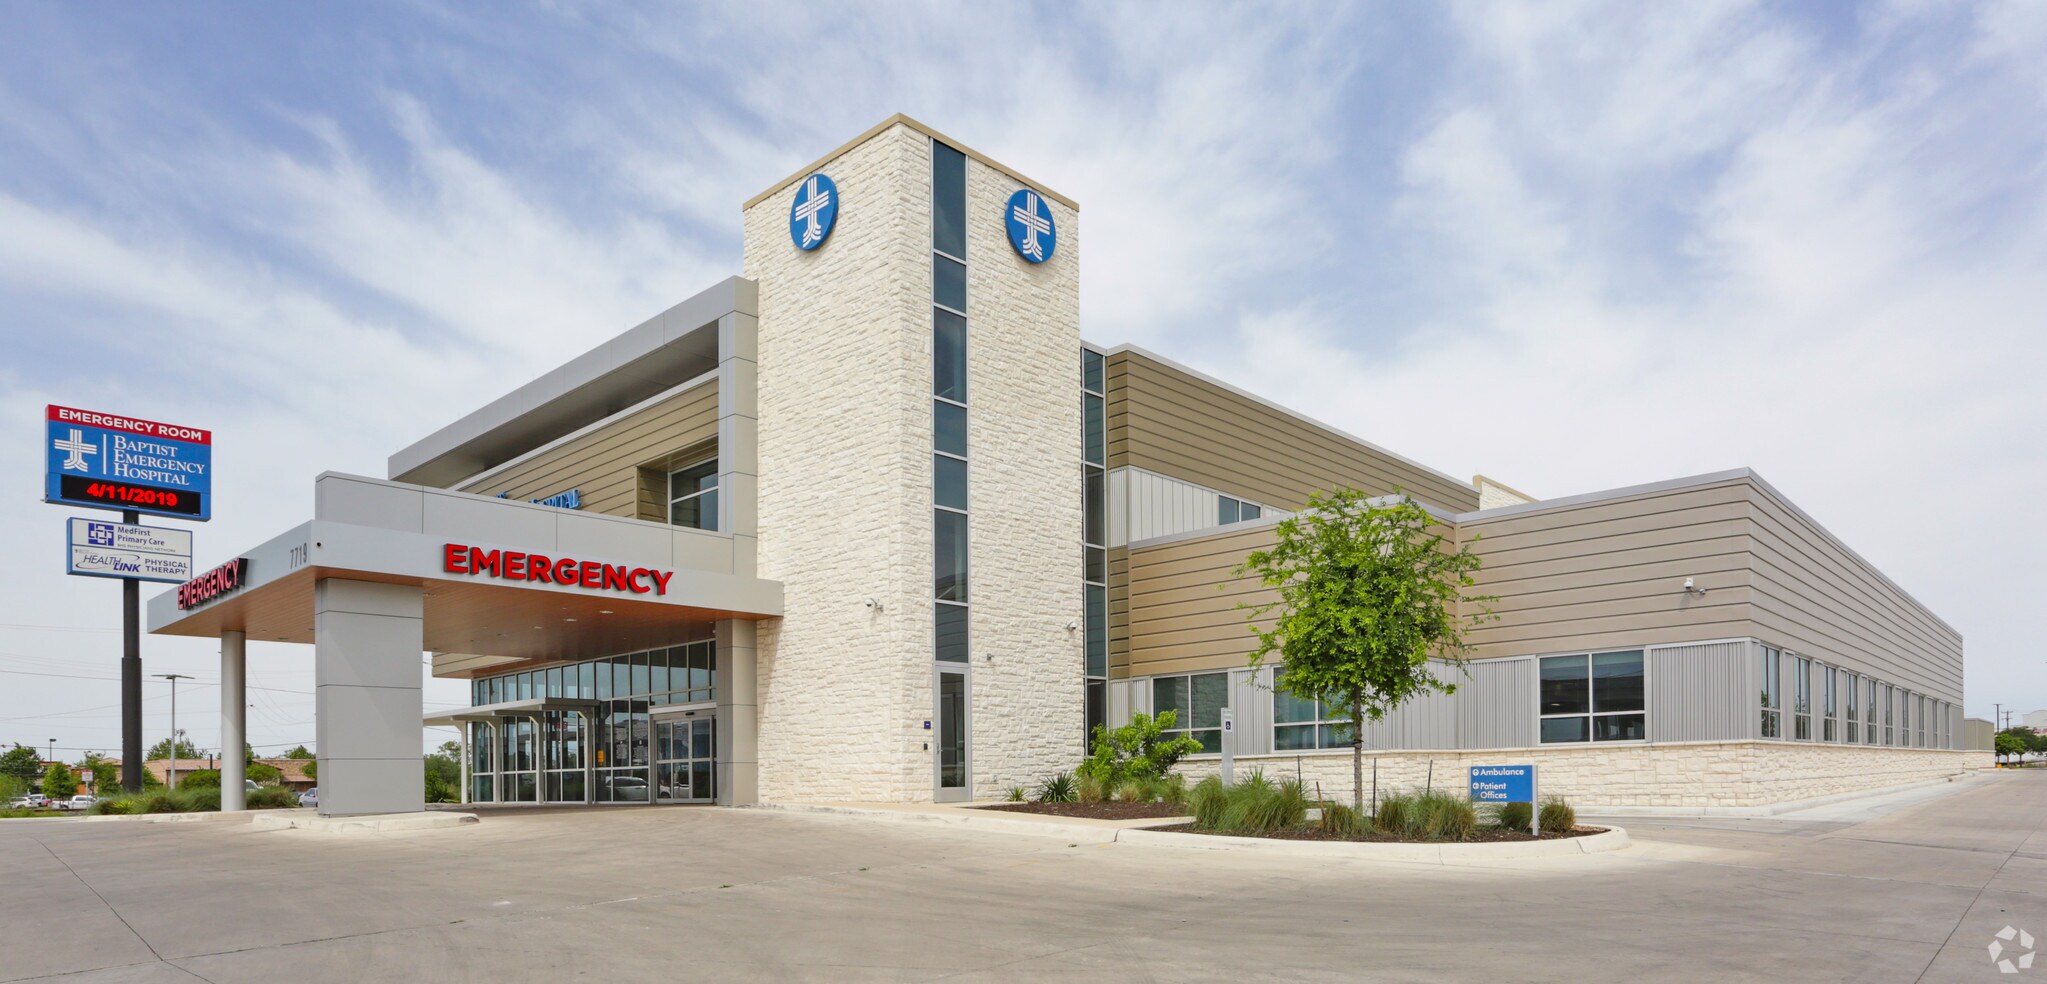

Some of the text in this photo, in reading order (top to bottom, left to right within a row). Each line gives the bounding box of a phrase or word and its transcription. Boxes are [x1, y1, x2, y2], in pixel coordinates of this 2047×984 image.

[59, 408, 202, 441] EMERGENCY ROOM
[113, 434, 178, 457] BAPTIST
[114, 449, 205, 474] EMERGENCY
[114, 463, 190, 486] HOSPITAL
[86, 483, 178, 507] 4/11/2019
[117, 526, 151, 536] MedFirst
[117, 534, 165, 546] Primary Care
[83, 554, 121, 566] HEALTH
[290, 542, 308, 569] 7719
[113, 563, 141, 573] LINK
[145, 558, 188, 569] PHYSICAL
[443, 543, 674, 596] EMERGENCY
[146, 565, 186, 575] THERAPY
[178, 558, 241, 610] EMERGENCY
[1480, 768, 1524, 776] Ambulance
[1480, 782, 1506, 790] Patient
[1480, 791, 1507, 799] Offices
